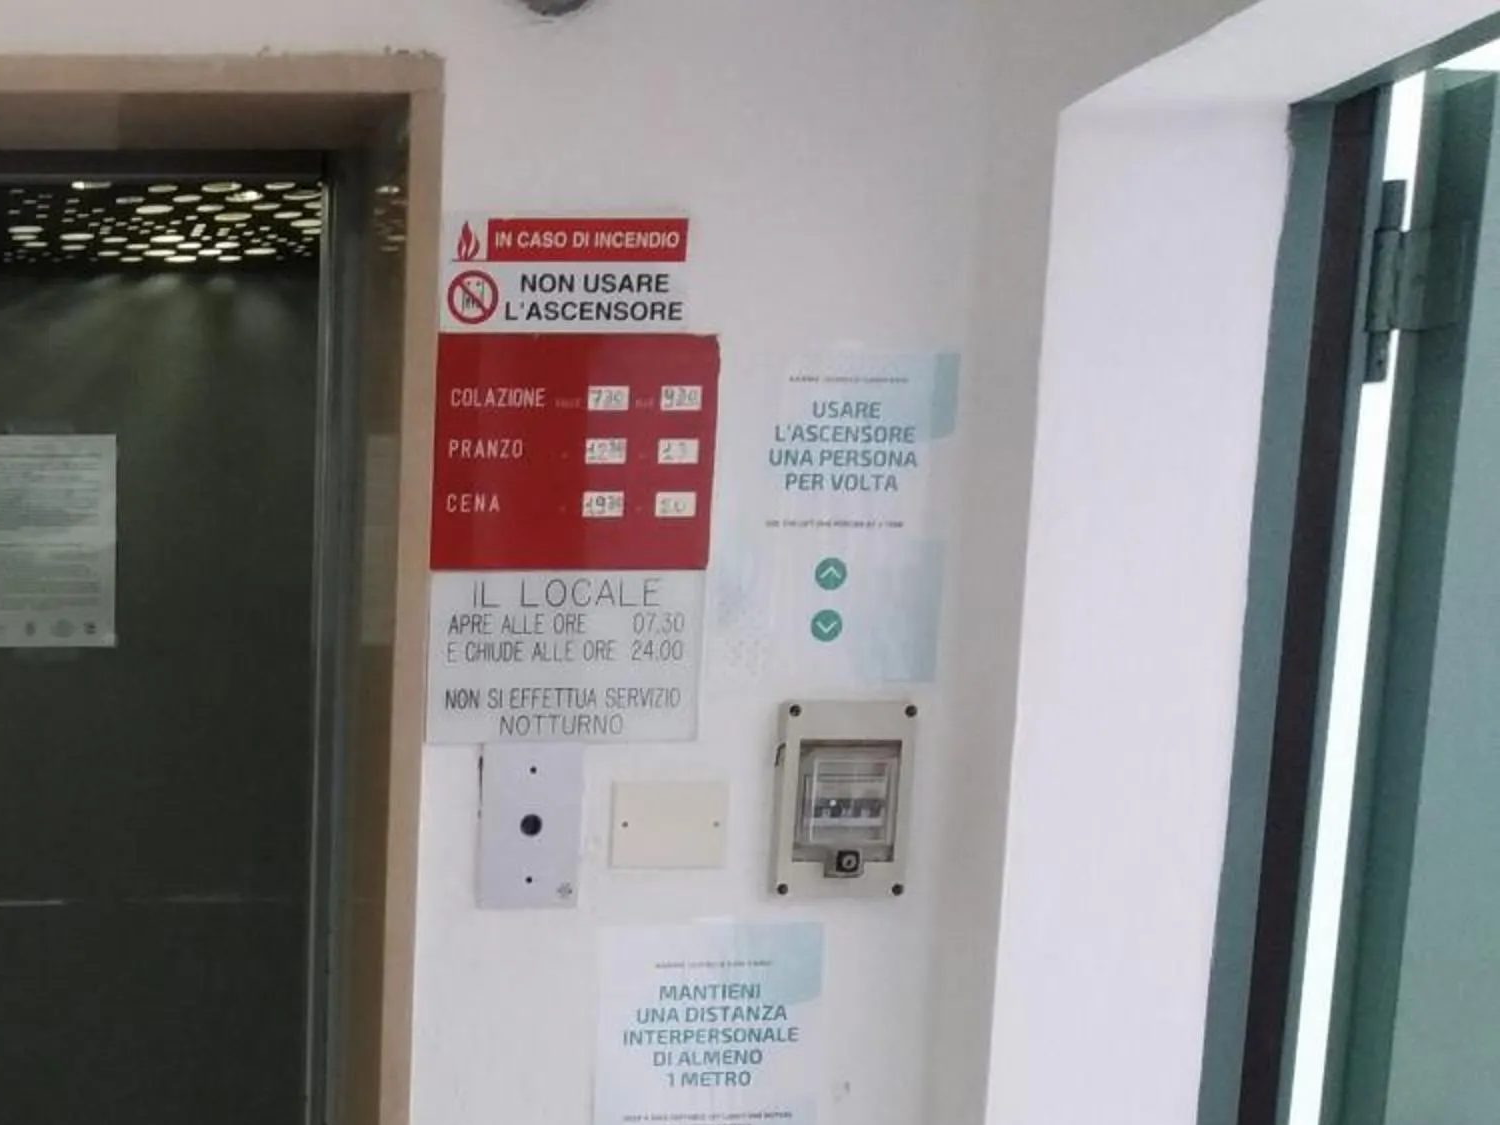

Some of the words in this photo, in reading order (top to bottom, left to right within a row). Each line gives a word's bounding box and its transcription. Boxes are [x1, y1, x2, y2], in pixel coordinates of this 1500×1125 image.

[495, 231, 513, 248] IN
[517, 231, 566, 248] CASO
[573, 231, 589, 248] DI
[594, 231, 680, 248] INCENDIO
[520, 274, 575, 293] NON
[583, 274, 670, 293] USARE
[504, 301, 684, 321] L'ASCENSORE
[450, 387, 547, 408] COLAZIONE
[812, 401, 882, 419] USARE
[774, 425, 916, 444] L'ASCENSORE
[448, 438, 524, 459] PRANZO
[768, 449, 813, 466] UNA
[819, 450, 918, 468] PERSONA
[784, 473, 824, 491] PER
[831, 474, 899, 492] VOLTA
[446, 493, 501, 513] CENA
[473, 580, 500, 609] IL
[520, 578, 662, 608] LOCALE
[448, 614, 492, 635] APRE
[501, 613, 544, 635] ALLE
[553, 613, 587, 634] ORE
[633, 612, 685, 634] 07.30
[447, 642, 458, 663] E
[465, 641, 524, 663] CHIUDE
[531, 641, 574, 662] ALLE
[583, 640, 616, 661] ORE
[631, 640, 684, 661] 24.00
[445, 689, 480, 710] NON
[487, 689, 503, 710] SI
[510, 688, 597, 710] EFFETTUA
[605, 687, 681, 709] SERVIZIO
[500, 714, 623, 736] NOTTURNO
[659, 982, 762, 1001] MANTIENI
[636, 1007, 679, 1024] UNA
[685, 1005, 787, 1023] DISTANZA
[623, 1026, 800, 1046] INTERPERSONALE
[653, 1050, 672, 1067] DI
[677, 1049, 763, 1067] ALMENO
[681, 1071, 751, 1088] METRO
